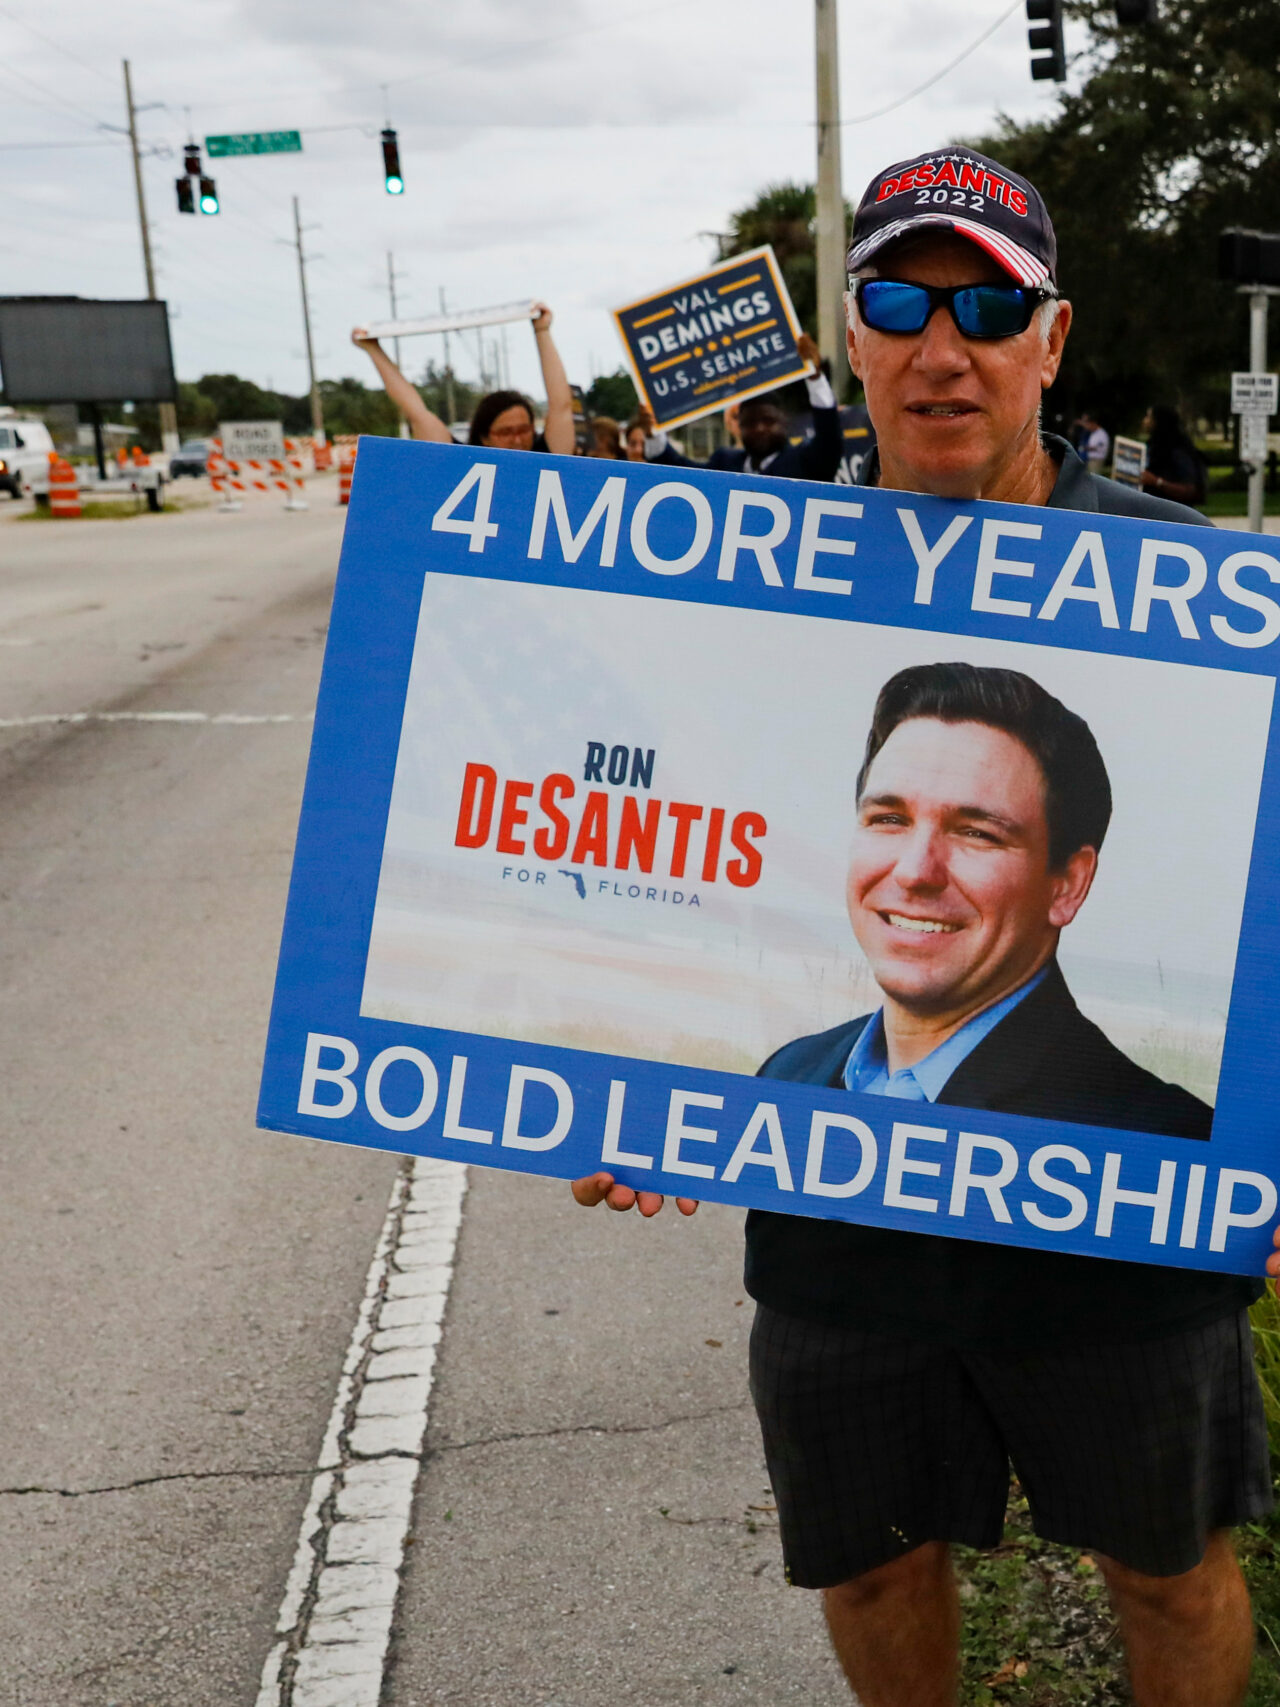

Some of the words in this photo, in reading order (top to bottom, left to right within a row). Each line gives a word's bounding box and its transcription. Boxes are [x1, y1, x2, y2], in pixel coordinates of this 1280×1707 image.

[875, 161, 1028, 217] DESANTIS
[914, 189, 985, 213] 2022
[637, 291, 772, 361] DEMINGS
[673, 288, 718, 315] VAL
[653, 370, 697, 397] U.S.
[701, 332, 786, 378] SENATE
[233, 428, 271, 439] ROAD
[431, 462, 499, 553] 4
[527, 469, 864, 595] MORE
[583, 741, 656, 789] RON
[502, 867, 547, 885] FOR
[598, 881, 701, 907] FLORIDA
[297, 1032, 574, 1152] BOLD
[601, 1079, 1278, 1253] LEADERSHIP
